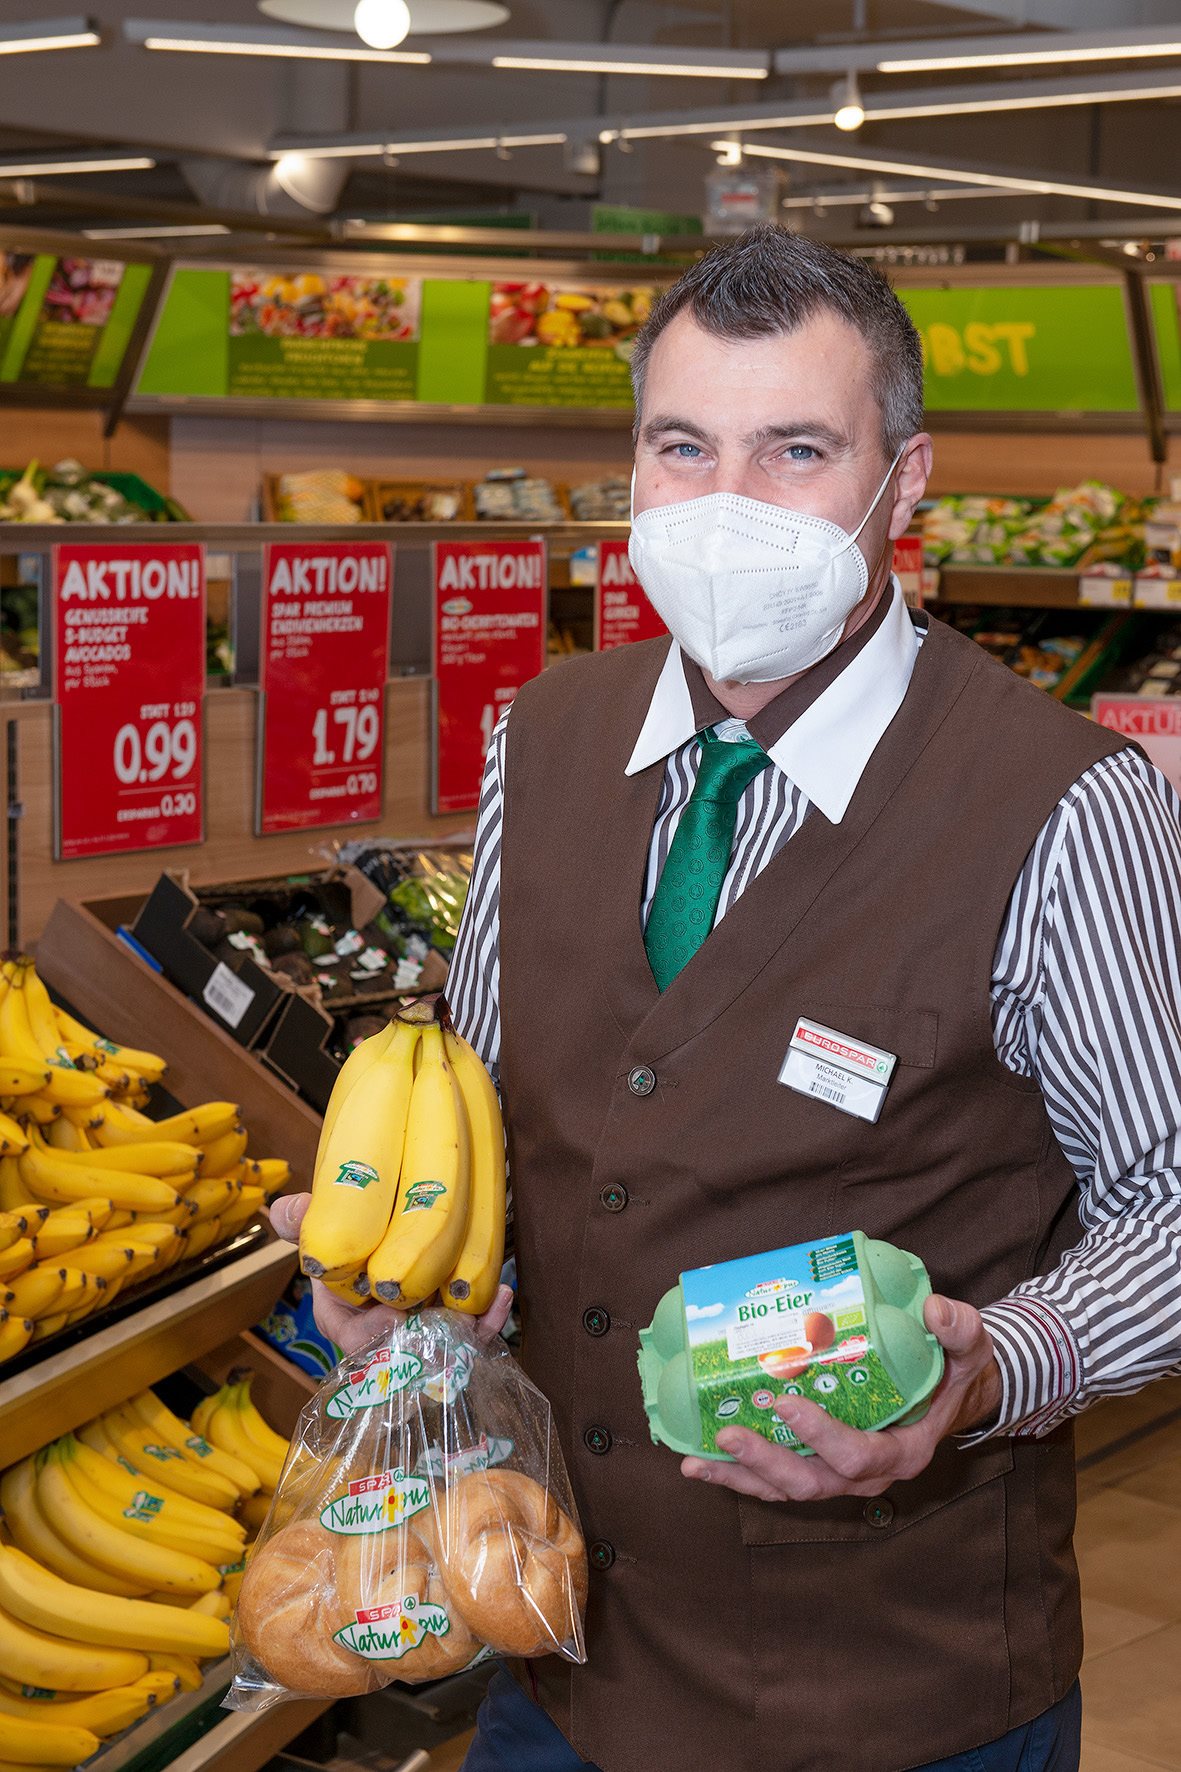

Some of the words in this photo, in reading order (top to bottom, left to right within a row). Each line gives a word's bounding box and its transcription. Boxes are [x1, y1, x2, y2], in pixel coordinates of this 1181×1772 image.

[922, 321, 1036, 377] BST
[61, 559, 200, 601] AKTION!
[270, 555, 387, 596] AKTION!
[439, 554, 541, 590] AKTION!
[602, 552, 638, 586] AK
[64, 625, 128, 644] S-BUDGET
[64, 643, 131, 663] AVOCADOS
[312, 704, 379, 766] 1.79
[1102, 707, 1181, 736] AKTU
[113, 719, 197, 784] 0.99
[347, 771, 377, 796] 0.70
[161, 791, 196, 817] 0.30
[803, 1031, 876, 1067] EUROSPAR
[815, 1063, 845, 1080] MICHAEL
[847, 1076, 854, 1085] K.
[738, 1292, 813, 1322] Bio-Eier
[330, 1497, 384, 1528] Natur
[339, 1625, 401, 1652] Natur
[418, 1614, 447, 1632] pur
